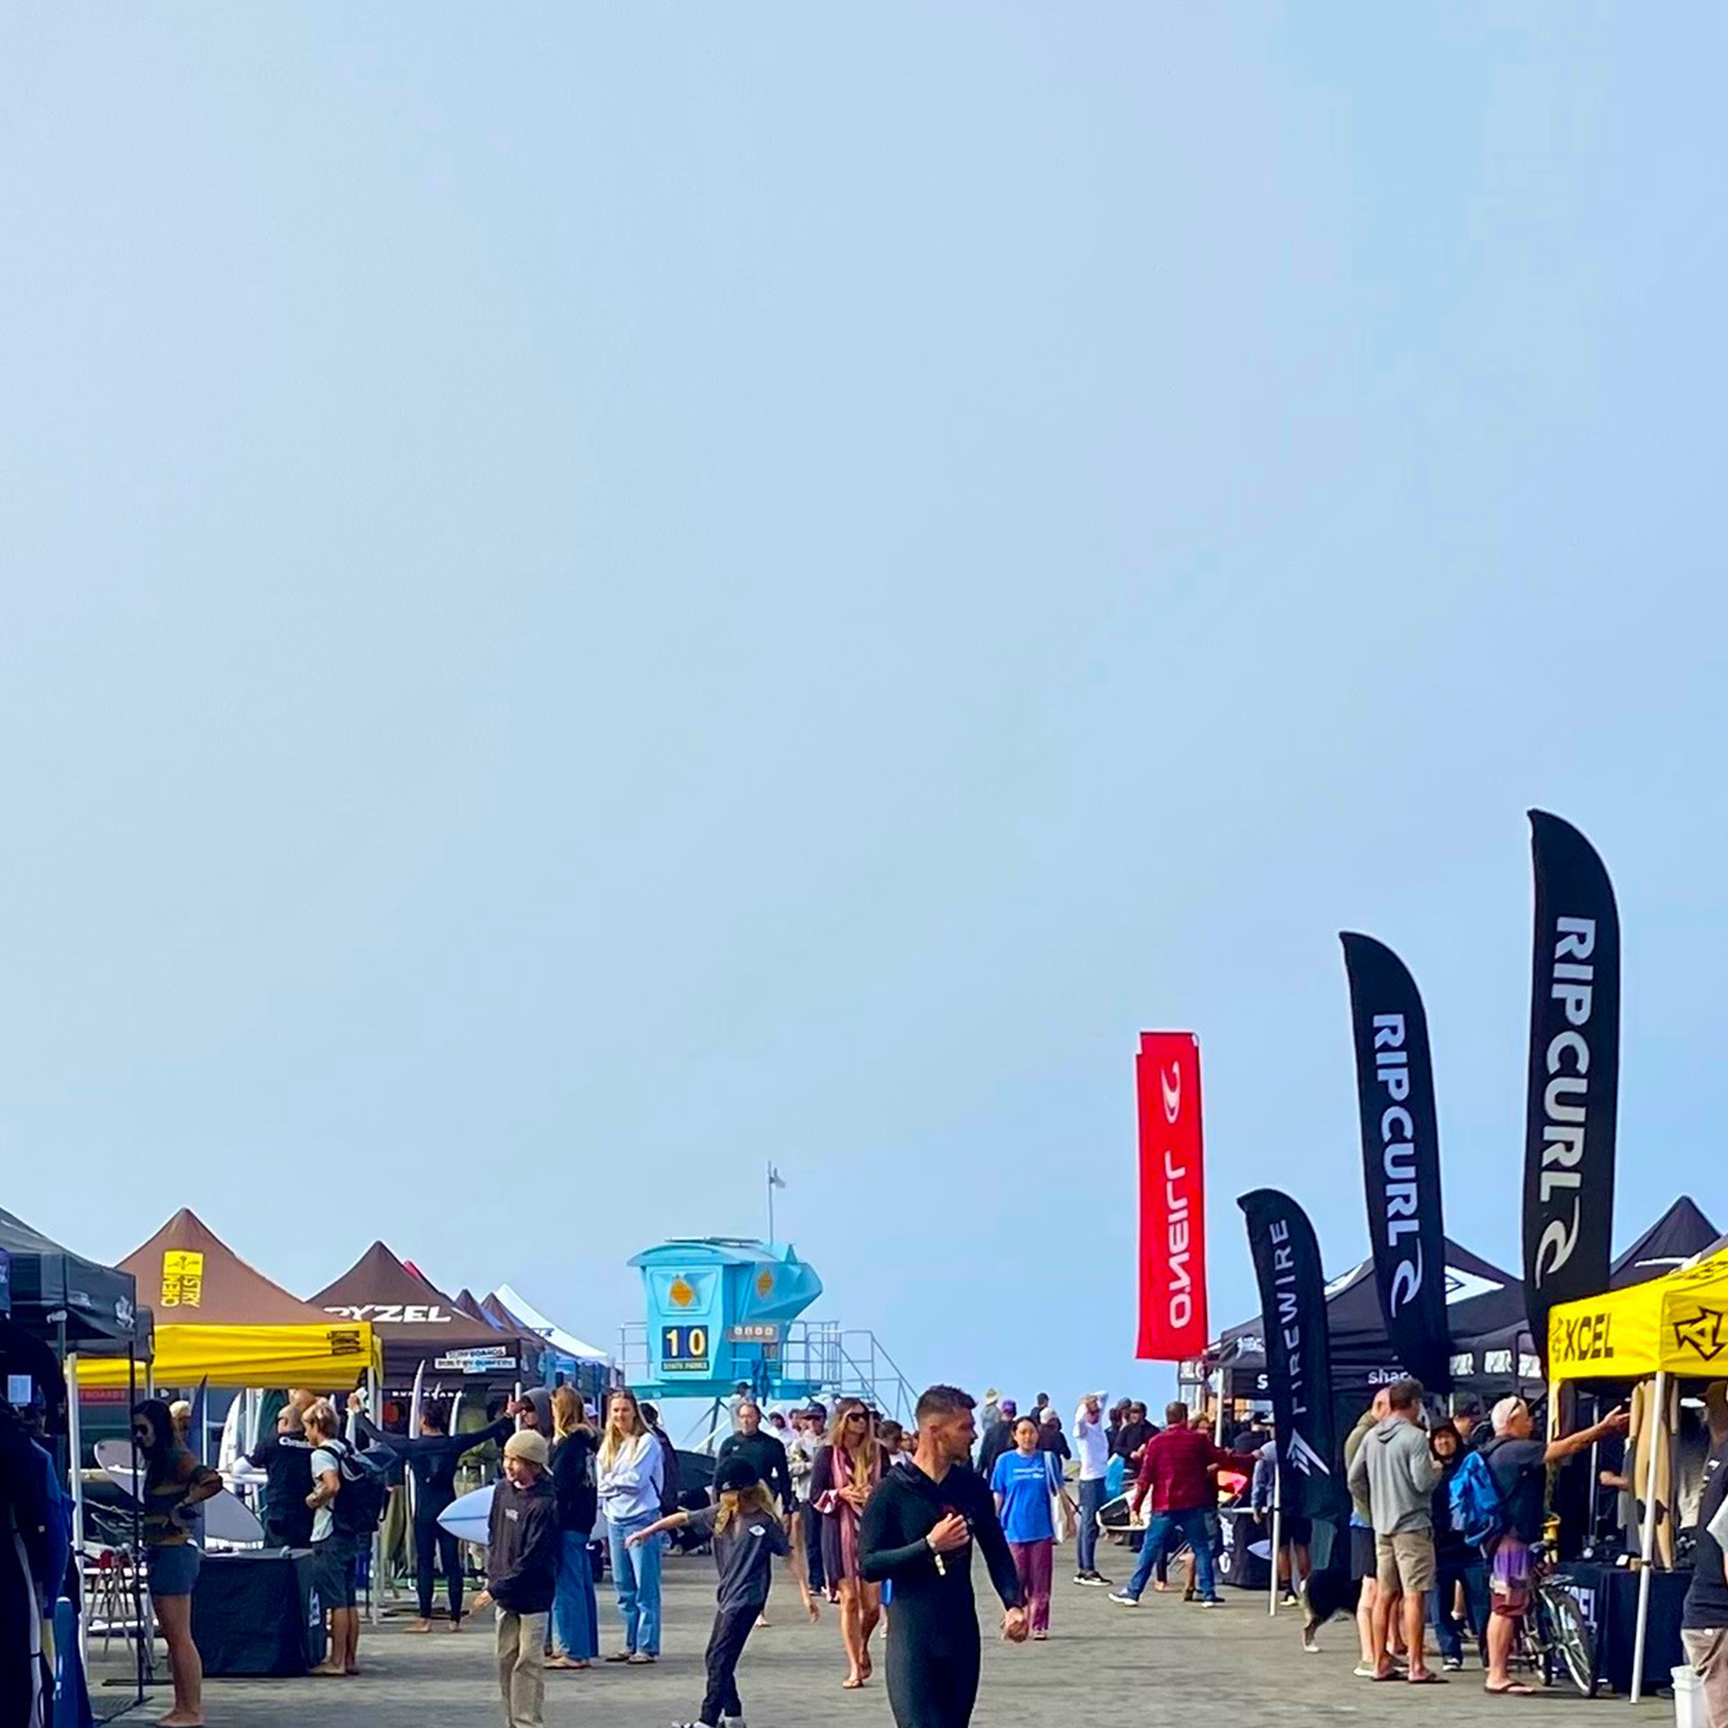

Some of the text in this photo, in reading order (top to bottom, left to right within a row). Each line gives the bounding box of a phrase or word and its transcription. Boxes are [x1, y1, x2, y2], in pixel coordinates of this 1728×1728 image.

[1539, 915, 1597, 1202] RIPCURL
[1373, 1012, 1419, 1247] RIPCURL
[666, 1328, 705, 1357] 10
[1270, 1219, 1308, 1415] FIREWIRE
[1368, 1369, 1414, 1384] shar
[1563, 1312, 1614, 1362] XCEL
